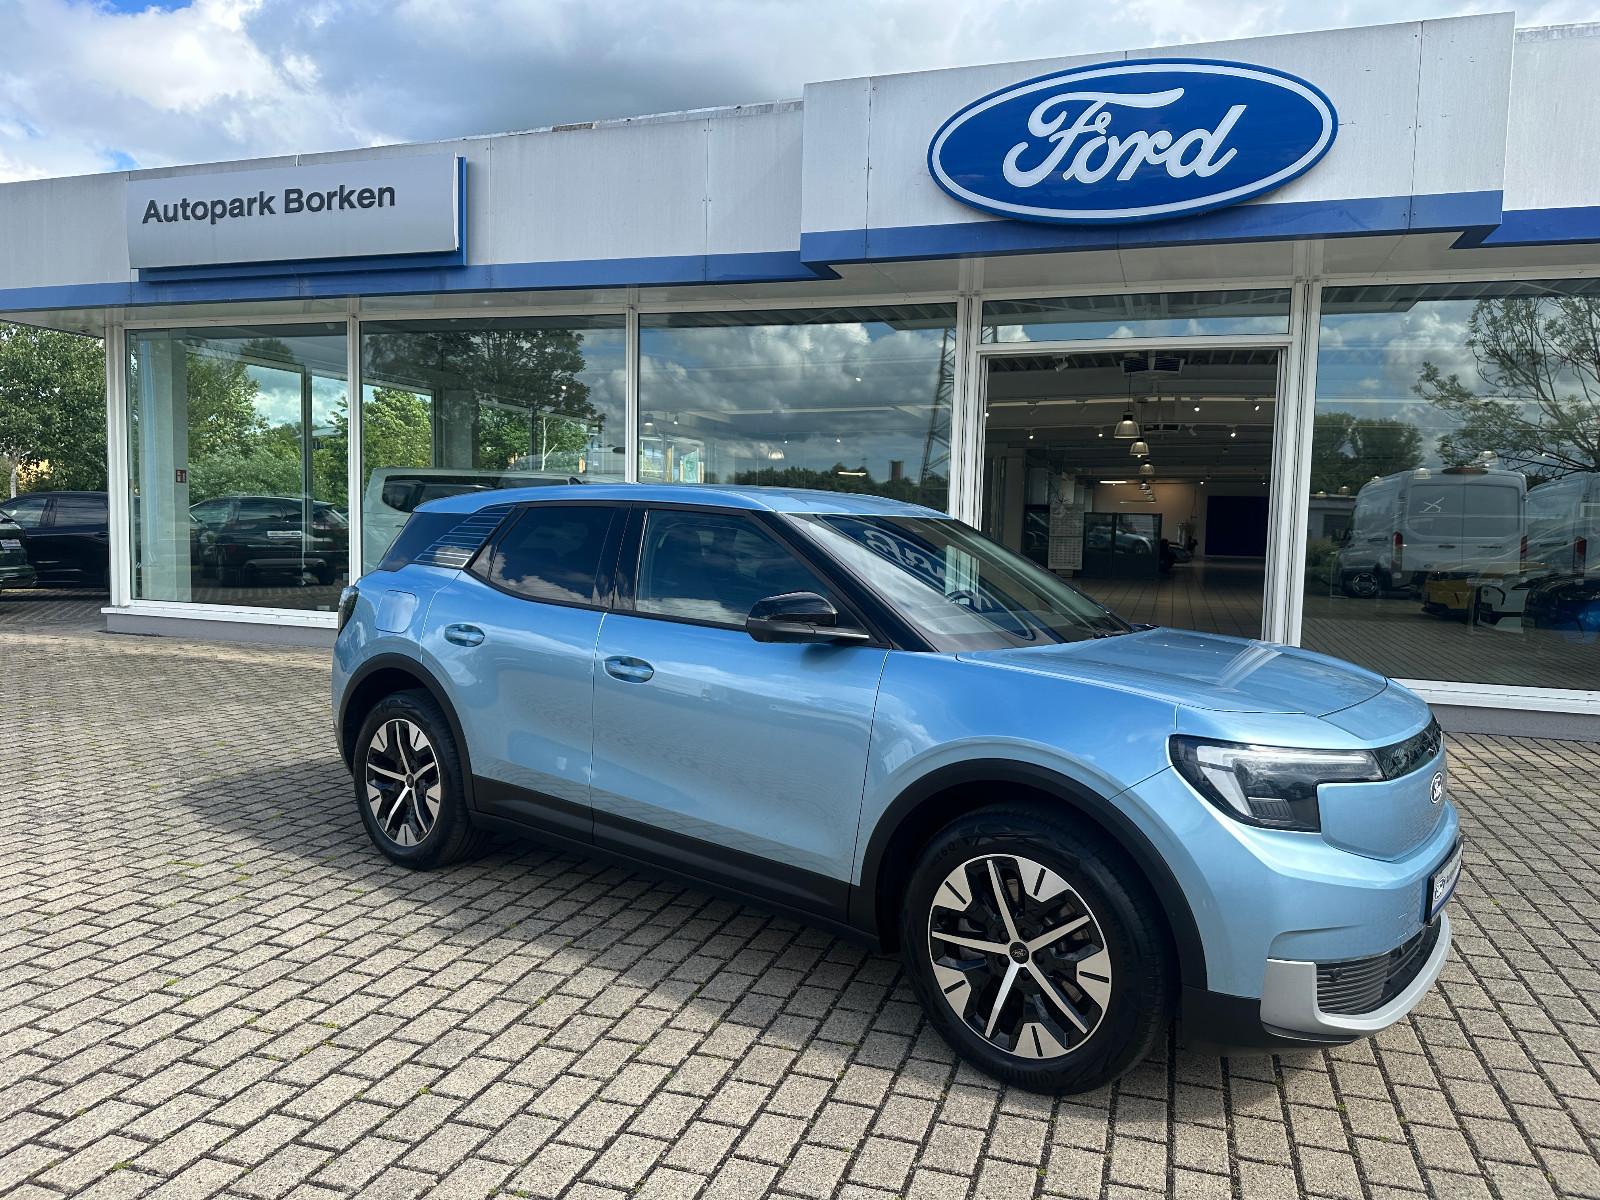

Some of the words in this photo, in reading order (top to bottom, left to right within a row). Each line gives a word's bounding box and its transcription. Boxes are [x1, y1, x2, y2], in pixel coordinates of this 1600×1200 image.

[1003, 87, 1247, 187] Ford
[142, 191, 276, 224] Autopark
[284, 185, 396, 214] Borken
